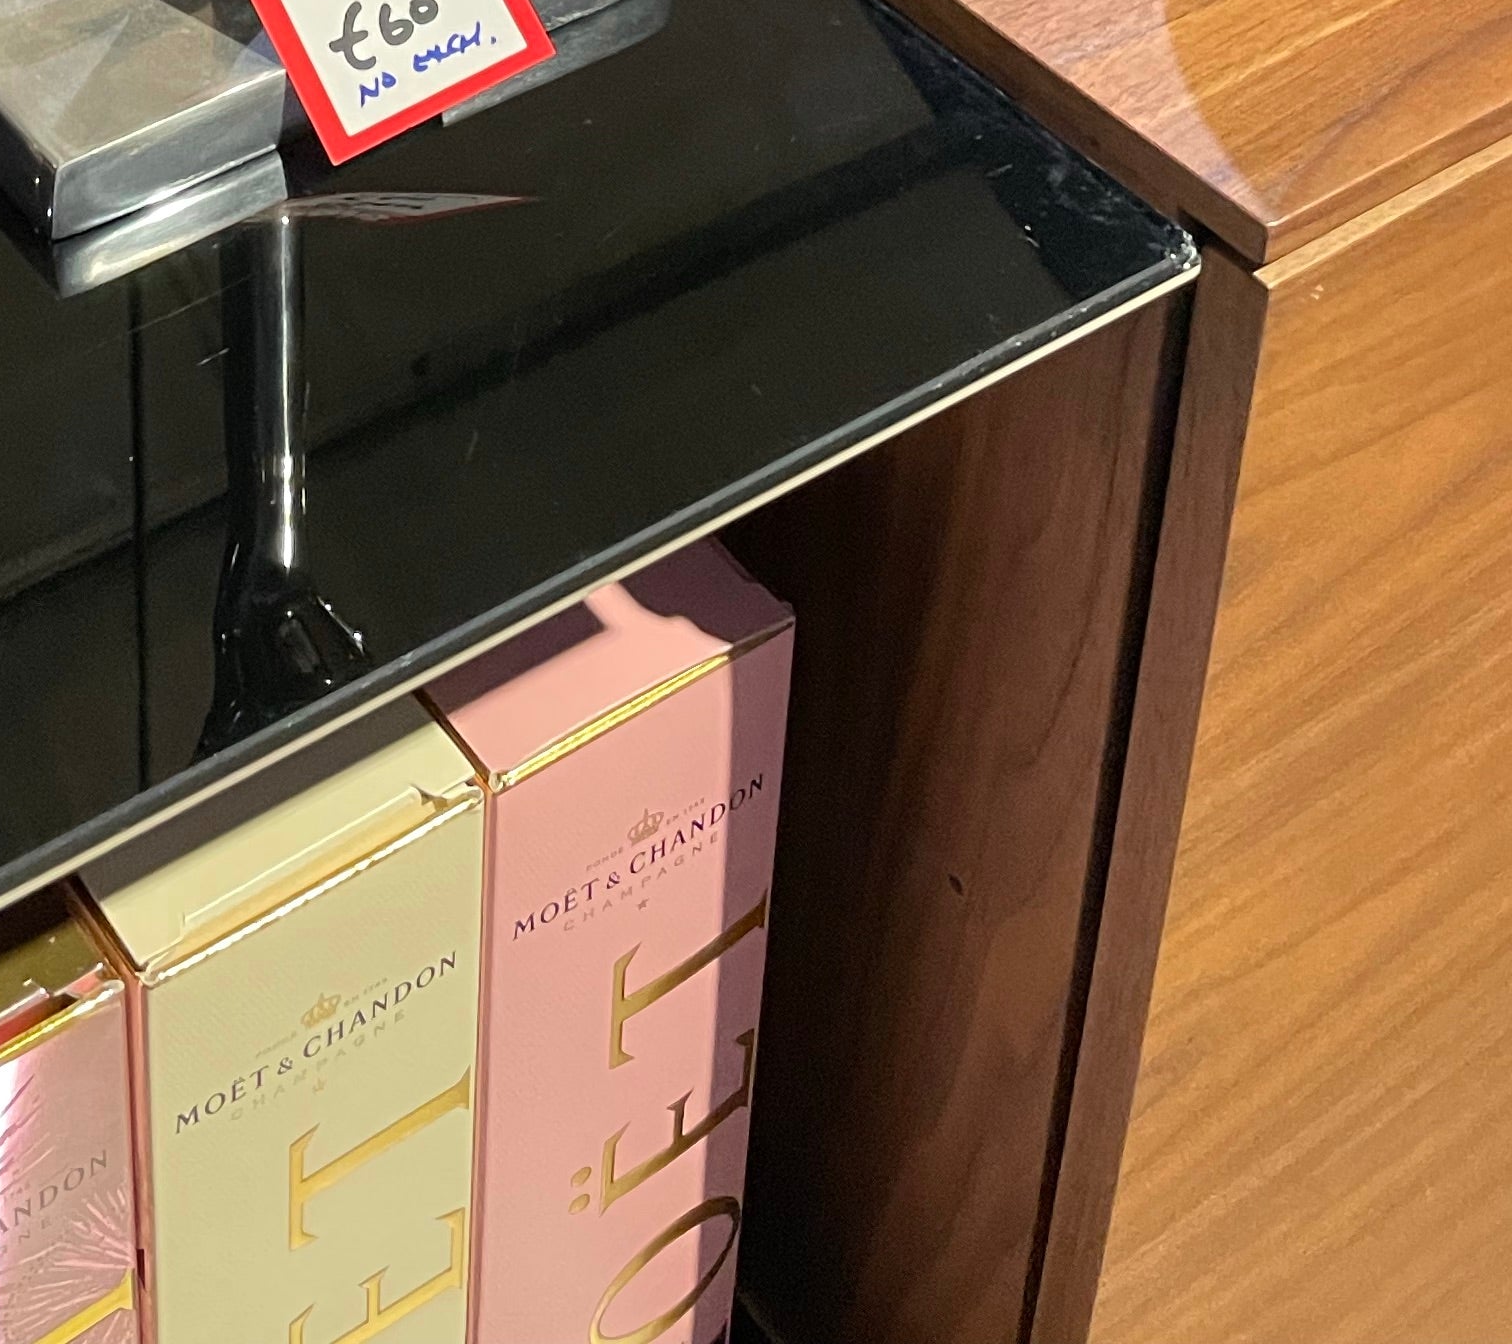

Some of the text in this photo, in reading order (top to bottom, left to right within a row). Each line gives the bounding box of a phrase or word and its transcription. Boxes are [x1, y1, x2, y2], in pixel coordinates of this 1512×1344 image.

[359, 71, 398, 109] NO
[562, 830, 720, 933] CHAMPAGNE
[606, 871, 621, 890] &
[629, 772, 764, 875] CHANDON
[276, 1056, 294, 1076] &
[302, 950, 457, 1059] CHANDON
[566, 887, 771, 1344] OËT
